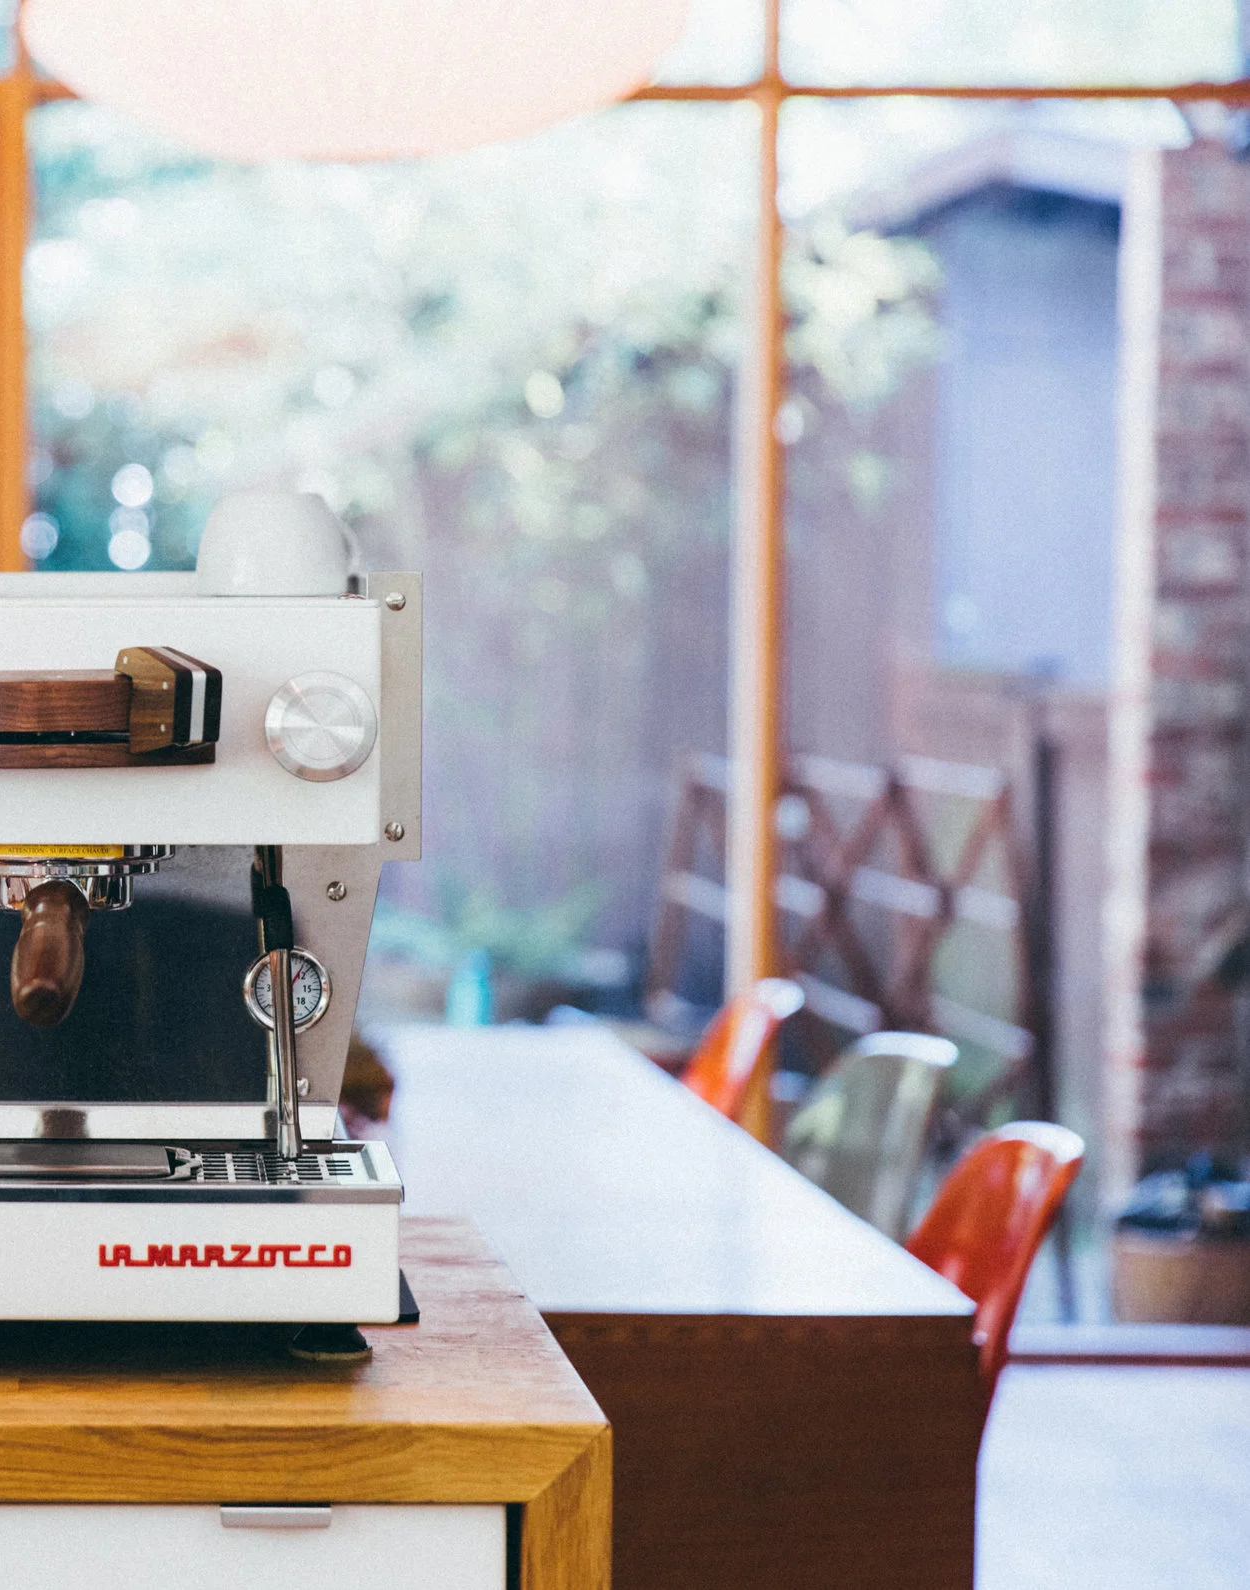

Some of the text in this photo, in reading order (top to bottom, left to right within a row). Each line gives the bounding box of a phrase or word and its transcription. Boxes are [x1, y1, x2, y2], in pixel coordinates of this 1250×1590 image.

[303, 985, 312, 993] 15
[99, 1244, 352, 1267] LA MARZOCCO
